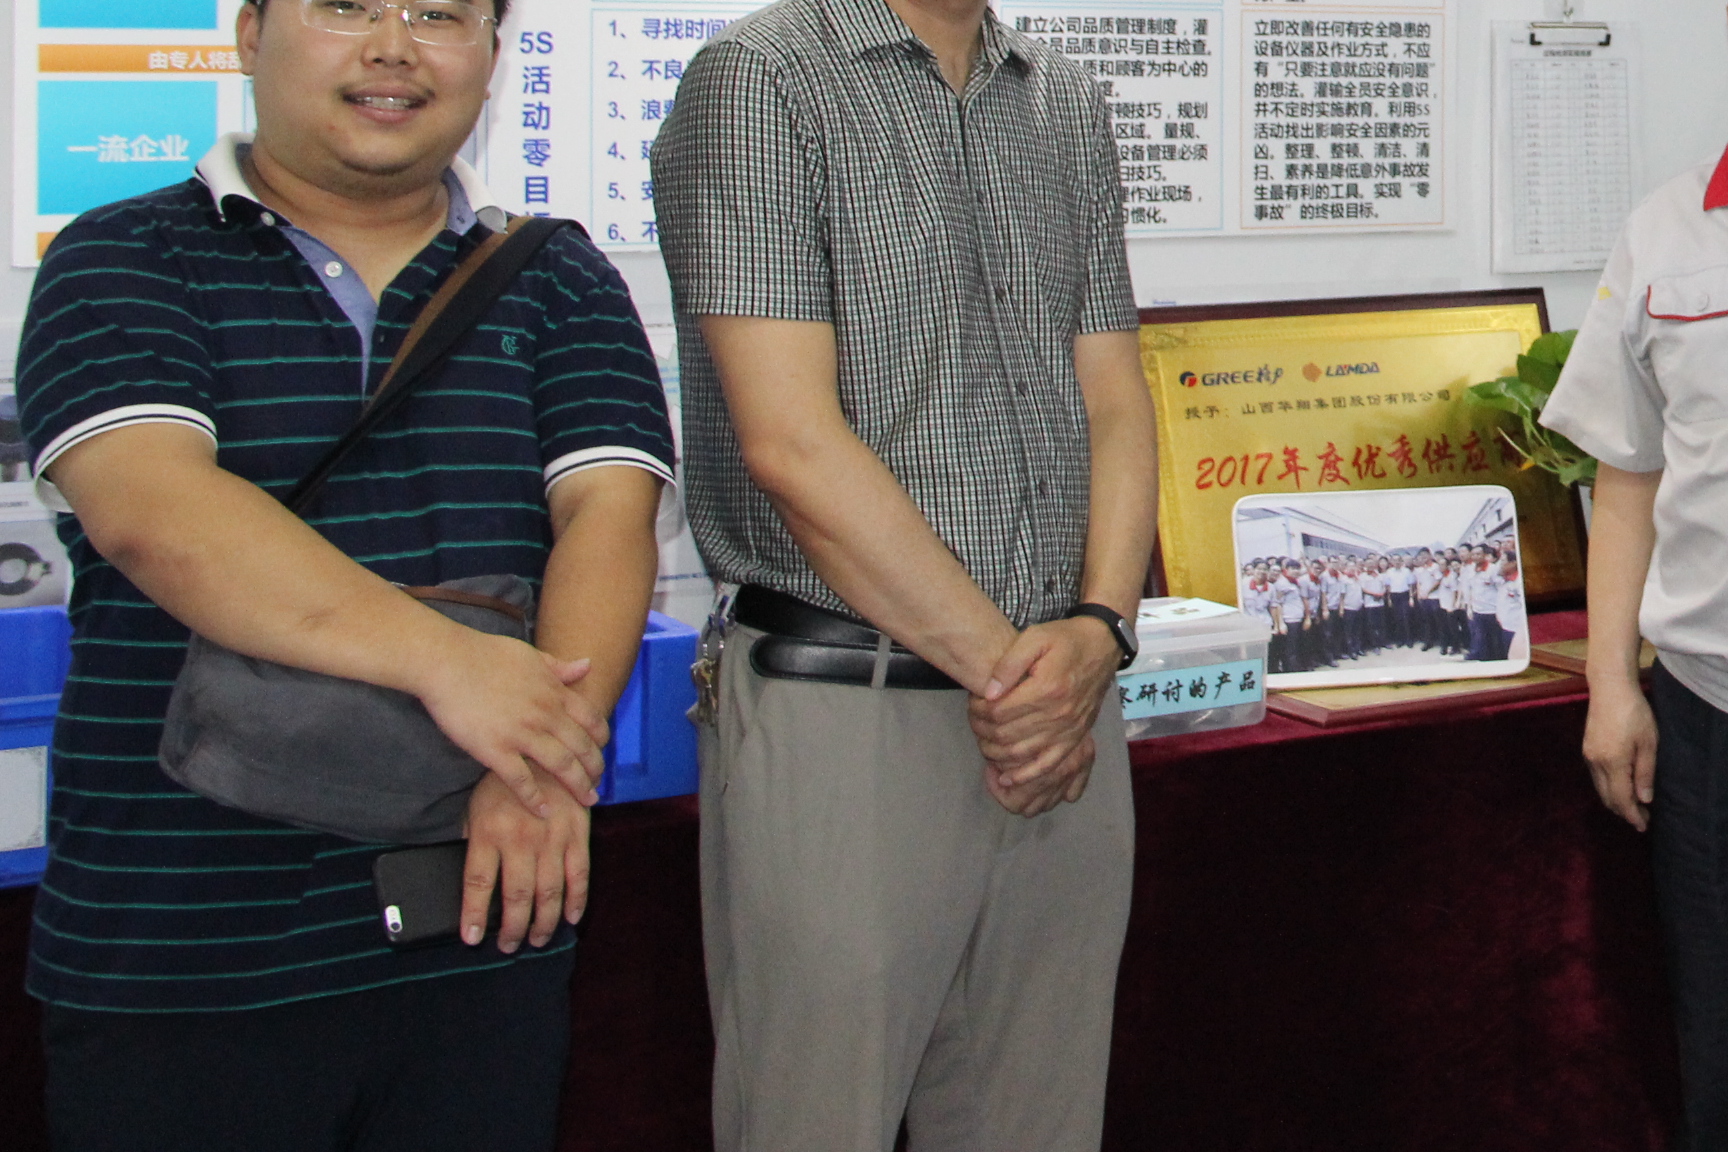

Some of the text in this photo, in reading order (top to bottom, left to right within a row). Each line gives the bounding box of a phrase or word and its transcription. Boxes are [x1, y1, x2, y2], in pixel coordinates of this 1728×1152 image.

[68, 134, 190, 163] 一流企业
[519, 32, 554, 217] 5S活动零目
